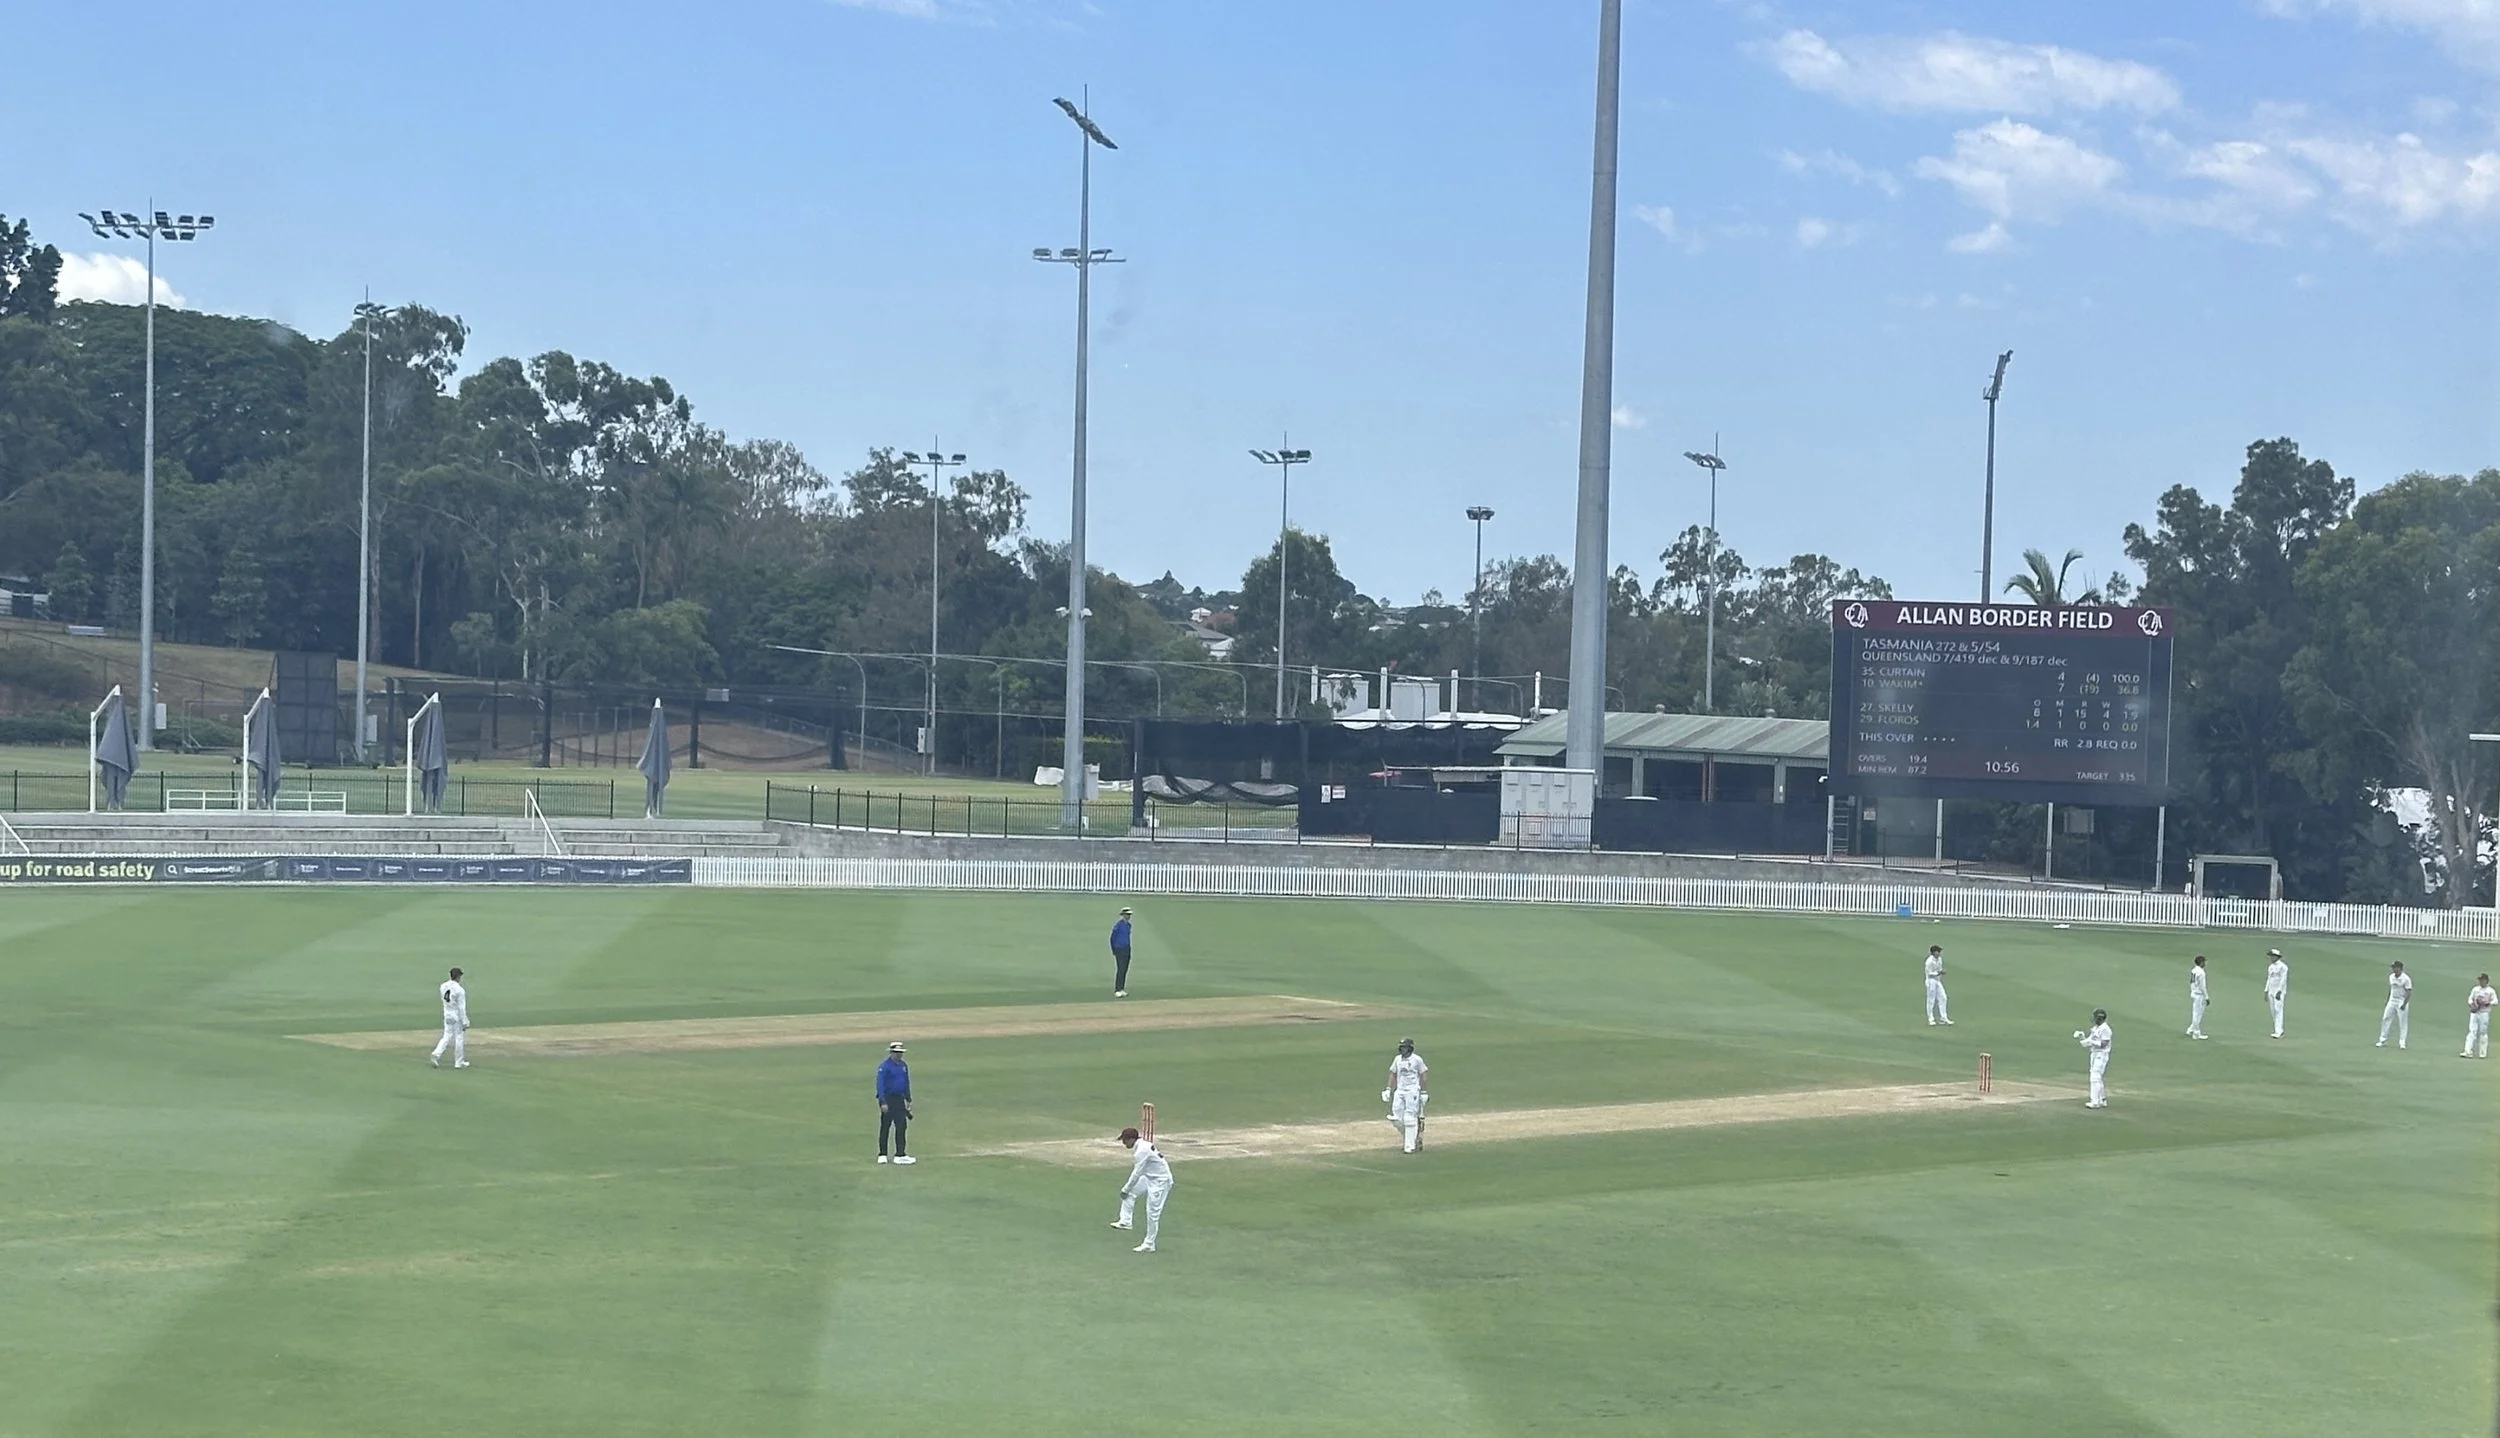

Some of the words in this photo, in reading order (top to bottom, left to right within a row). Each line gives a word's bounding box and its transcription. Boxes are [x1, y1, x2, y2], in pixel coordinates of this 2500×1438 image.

[1896, 606, 1964, 626] ALLAN
[1969, 609, 2054, 629] BORDER
[2058, 611, 2114, 630] FIELD
[1862, 638, 1934, 651] TASMANIA
[1936, 641, 1956, 652] 272
[1959, 642, 1969, 652] &
[1971, 641, 2000, 653] 5/54
[1862, 651, 1941, 663] QUEENSLAND
[1943, 653, 1975, 665] 7/419
[1977, 654, 1997, 664] dec
[2000, 655, 2010, 665] &
[2012, 655, 2044, 667] 9/187
[2048, 656, 2068, 667] dec
[1879, 667, 1926, 678] CURTAIN
[2057, 671, 2065, 681] 4
[2085, 672, 2100, 685] (4)
[2112, 673, 2141, 684] 100.0
[2058, 682, 2065, 692] 7
[1878, 703, 1915, 713] SKELLY
[2074, 709, 2087, 718] 15
[2102, 710, 2110, 719] 4
[1859, 732, 1882, 742] THIS
[1885, 732, 1915, 743] OVER
[2054, 738, 2068, 749] RR
[2095, 740, 2118, 750] REQ
[2121, 740, 2138, 750] 0.0
[1985, 761, 2020, 774] 10:56
[26, 861, 52, 877] for
[56, 862, 95, 878] road
[98, 861, 155, 880] safety
